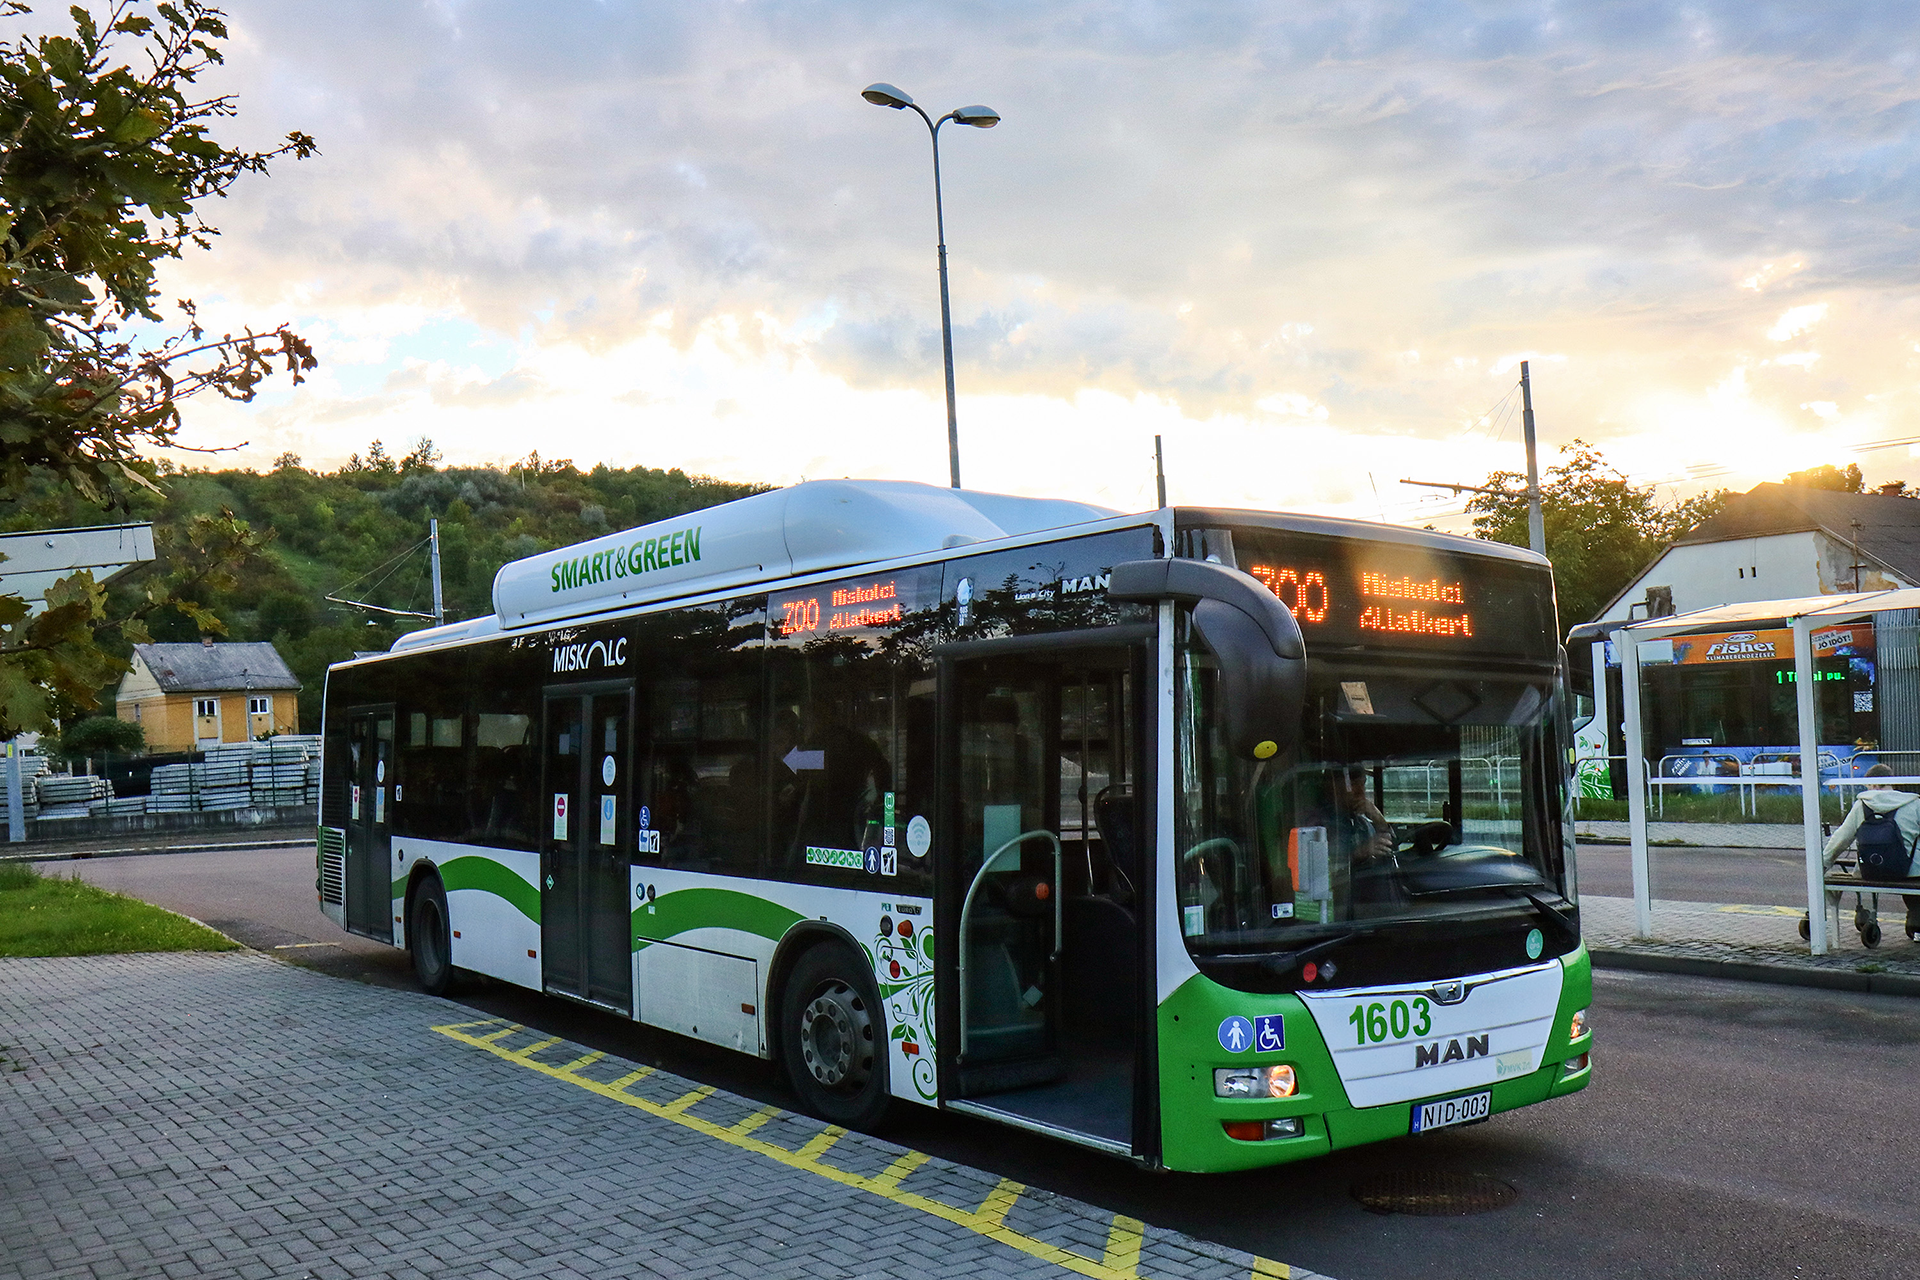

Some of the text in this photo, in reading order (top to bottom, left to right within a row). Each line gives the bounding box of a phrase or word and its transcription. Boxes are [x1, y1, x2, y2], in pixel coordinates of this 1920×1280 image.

[551, 526, 702, 593] SMART&GREEN
[832, 580, 897, 607] Miskolci
[1061, 573, 1111, 595] MAN
[1363, 572, 1465, 604] Miskolci
[1706, 642, 1775, 656] Fisher
[1776, 670, 1845, 684] 1 Tiai pu.
[1350, 997, 1432, 1045] 1603
[1416, 1034, 1490, 1069] MAN
[1413, 1095, 1488, 1129] H NID-003
